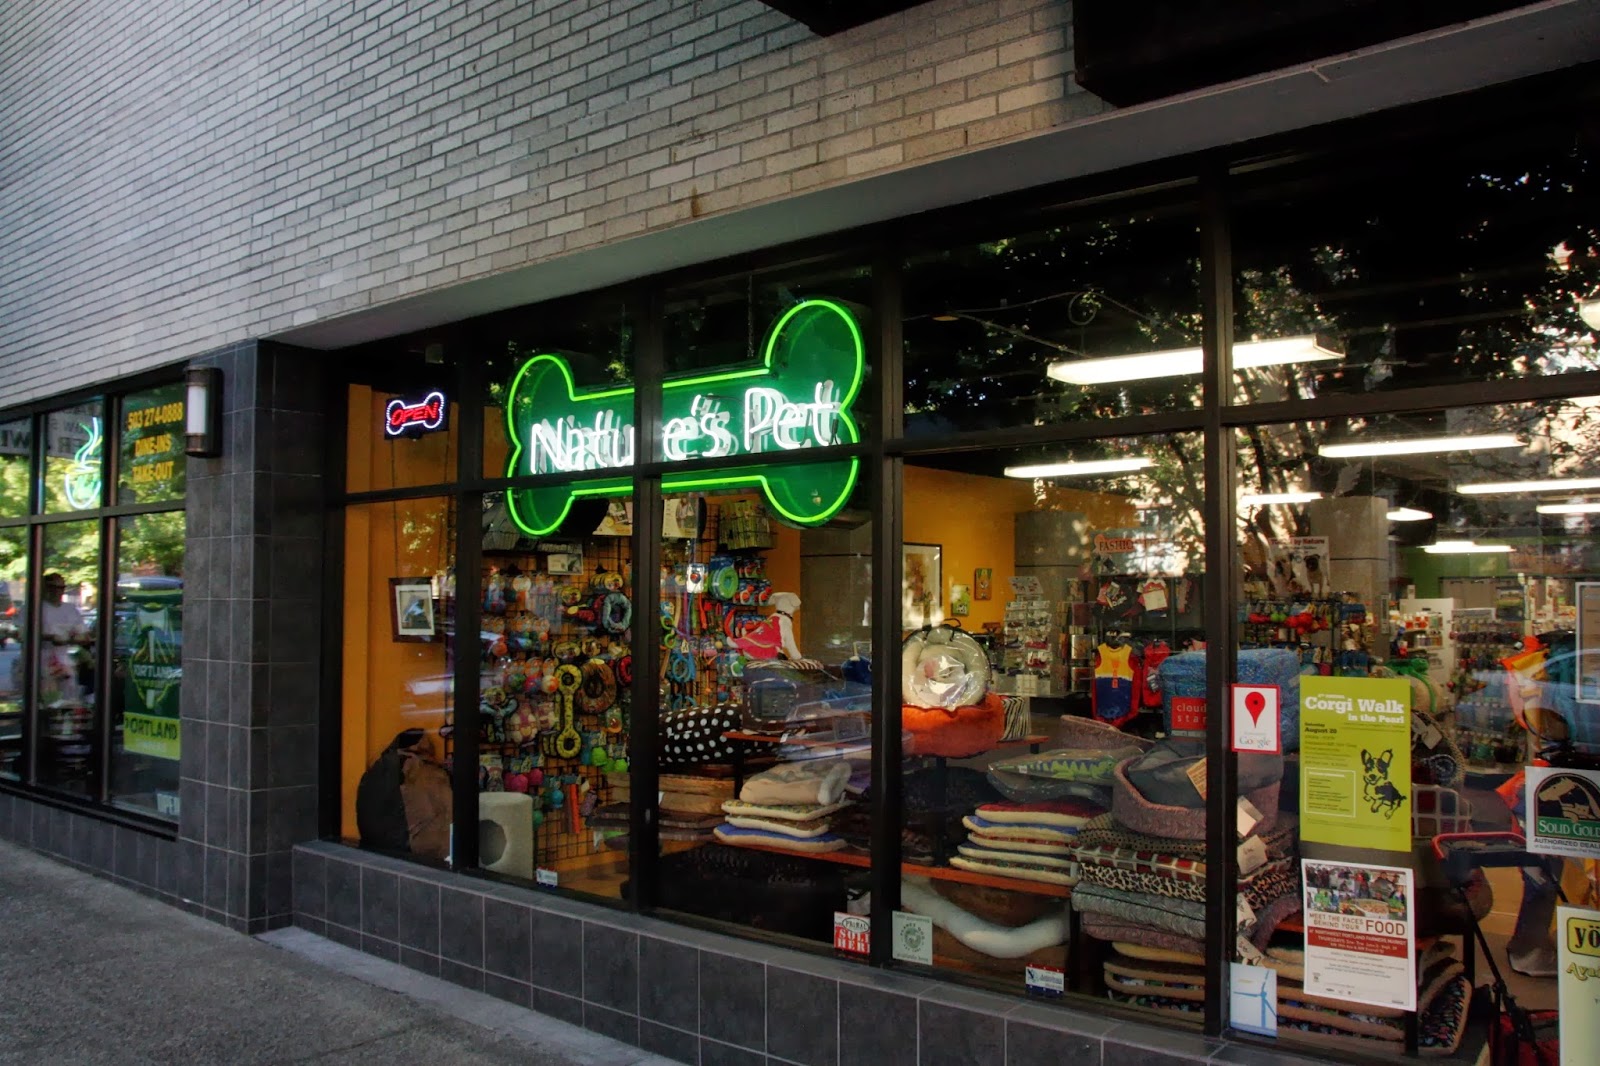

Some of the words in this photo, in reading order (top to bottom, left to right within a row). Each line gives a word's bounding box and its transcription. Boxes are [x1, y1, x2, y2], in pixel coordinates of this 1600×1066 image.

[127, 410, 143, 431] 503
[391, 402, 439, 426] OPEN
[531, 394, 724, 474] Natue's
[744, 382, 833, 451] Pet
[132, 461, 174, 481] TAKE-OUT
[1176, 703, 1207, 713] cloud
[1305, 696, 1353, 714] Corgi
[1357, 699, 1404, 714] Walk
[1348, 713, 1358, 721] in
[1360, 714, 1376, 722] the
[1378, 715, 1404, 724] Pearl
[1239, 736, 1272, 748] Google
[1539, 820, 1570, 835] SOLID
[1535, 838, 1578, 847] AUTHORIZED
[846, 920, 866, 930] PRIMAL
[1314, 920, 1339, 928] BEHIND
[1366, 920, 1405, 936] FOOD
[1566, 962, 1600, 981] Ava
